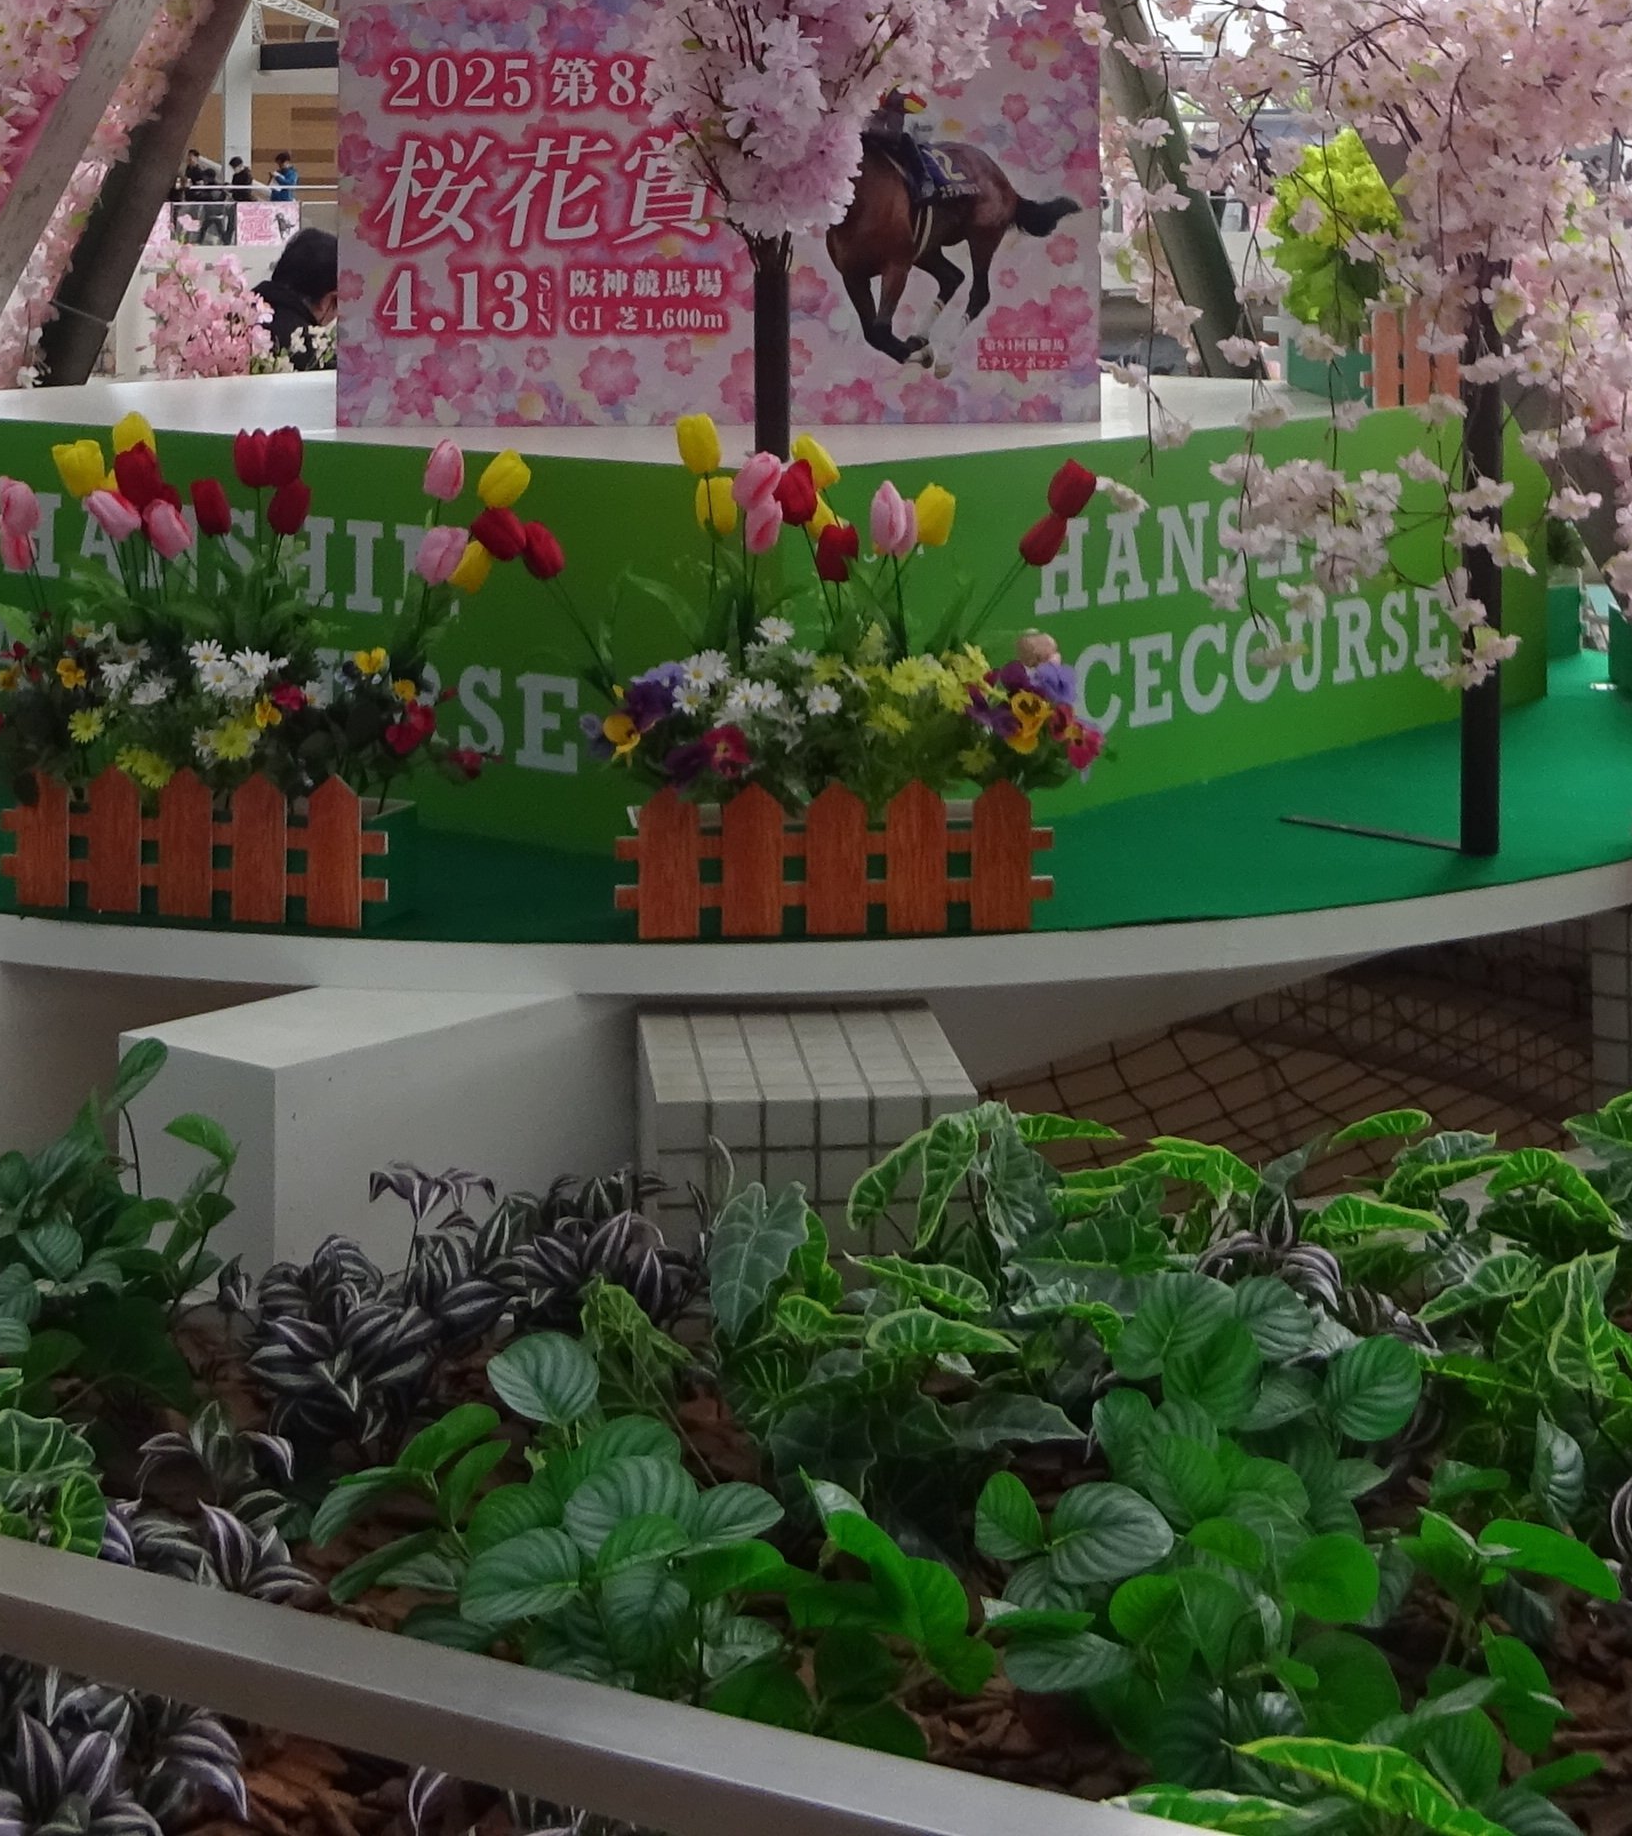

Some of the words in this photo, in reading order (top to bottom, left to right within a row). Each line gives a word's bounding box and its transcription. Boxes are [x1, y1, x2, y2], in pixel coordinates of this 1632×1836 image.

[388, 57, 533, 108] 2025
[381, 269, 530, 332] 4.13
[569, 268, 723, 298] 阪神競馬場
